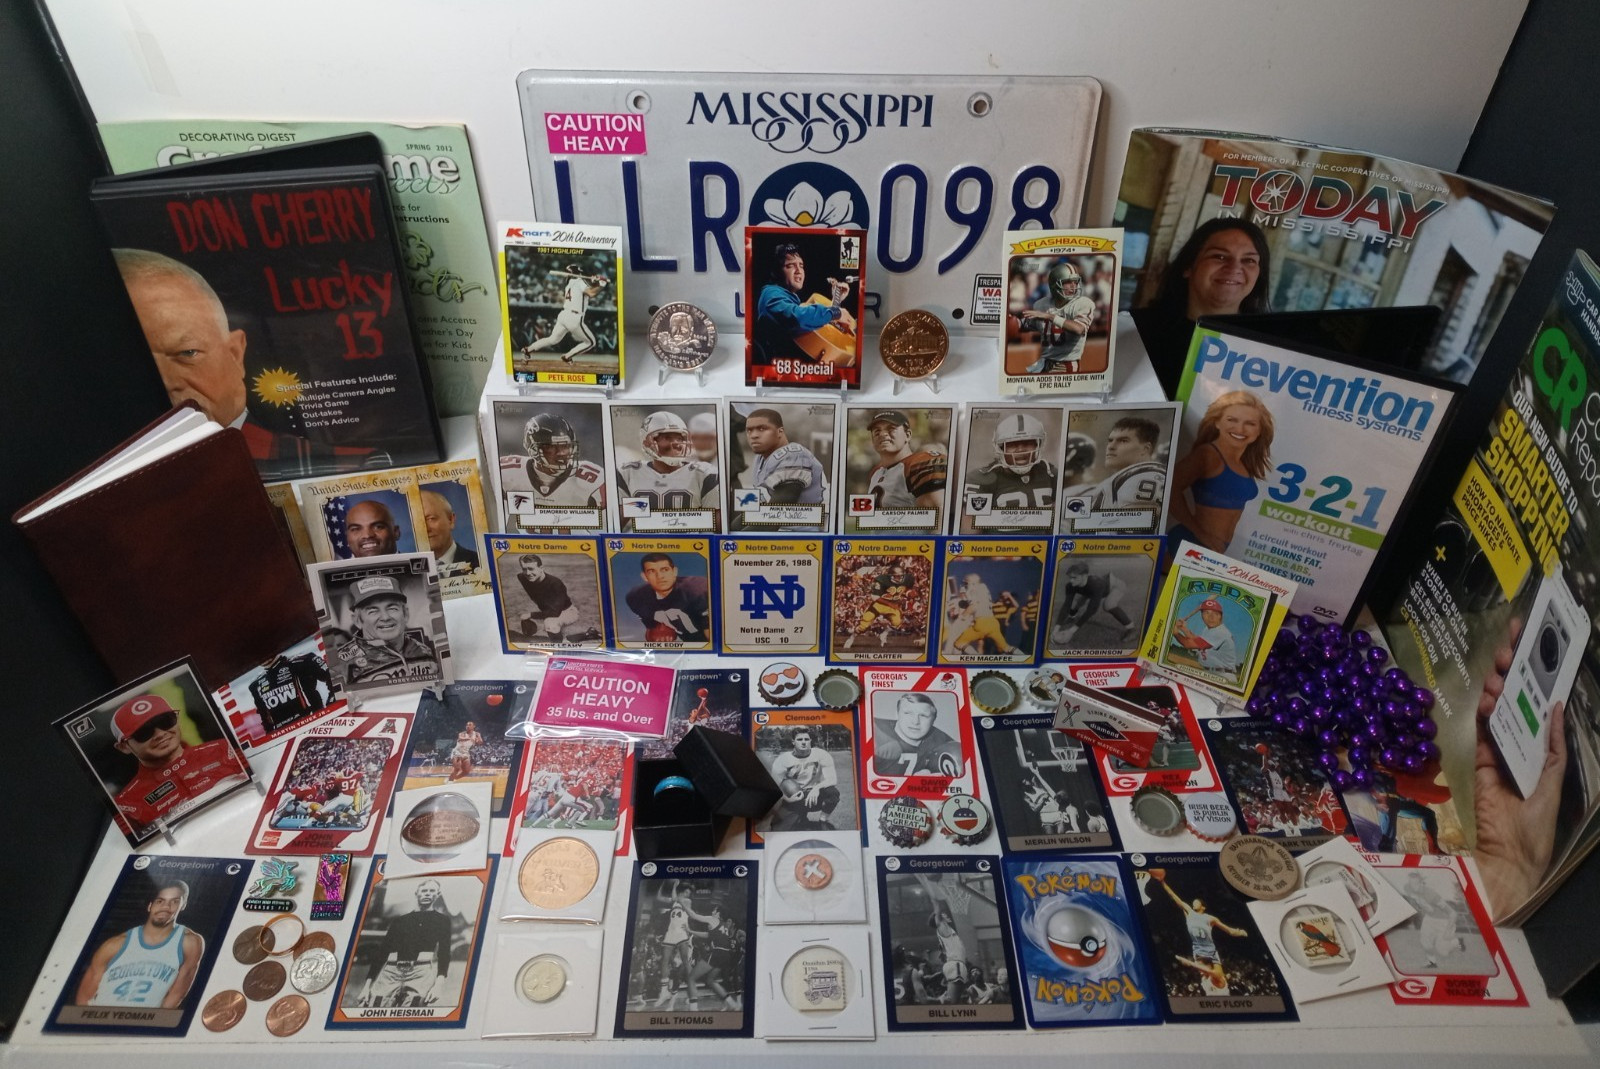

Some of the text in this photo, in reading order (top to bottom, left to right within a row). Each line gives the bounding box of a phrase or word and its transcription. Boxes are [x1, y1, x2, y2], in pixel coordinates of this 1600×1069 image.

[546, 114, 642, 132] CAUTION
[686, 91, 933, 154] MISSISSIPPI
[179, 133, 296, 142] DECORATING DIGEST
[563, 136, 629, 152] HEAVY
[1223, 152, 1239, 160] FOR
[1241, 153, 1278, 164] MEMBERS
[1279, 157, 1290, 165] OF
[1291, 158, 1329, 172] ELECTRIC
[1330, 165, 1391, 181] COOPERATIVES
[1215, 164, 1448, 240] TODAY
[167, 187, 377, 253] DON CHERRY
[552, 231, 574, 242] 20th
[575, 231, 617, 247] Anniversary
[1027, 237, 1100, 249] FLASHBACKS
[264, 259, 393, 319] Lucky
[335, 310, 385, 360] 13
[793, 361, 834, 377] Special
[276, 373, 398, 392] Special Features Include:
[548, 374, 586, 382] PETE ROSE
[1006, 376, 1035, 384] MONTANA
[1193, 335, 1436, 432] Prevention
[1533, 327, 1587, 430] CR
[296, 385, 396, 403] Multiple Camera Angles
[299, 399, 350, 411] Trivia Game
[302, 408, 343, 419] Out-takes
[1302, 398, 1424, 441] fitness systems
[305, 416, 360, 429] Don's Advice
[1512, 390, 1579, 515] OUR NEW GUIDE TO
[433, 466, 472, 480] Congress
[1500, 408, 1570, 546] SMARTER
[307, 476, 412, 497] United States Congress
[1465, 485, 1500, 540] SHORTAGES
[1485, 436, 1560, 579] SHOPPING
[1266, 504, 1353, 540] workout
[1462, 493, 1497, 551] PRICE HIKES
[1470, 476, 1521, 565] HOW TO NAVIGATE
[518, 543, 568, 552] Notre Dame
[745, 543, 795, 552] Notre Dame
[1248, 539, 1267, 551] that
[1270, 546, 1303, 562] BURNS
[1259, 533, 1289, 548] circuit
[1290, 543, 1327, 559] workout
[733, 558, 812, 569] November 26, 1988
[1244, 548, 1288, 568] FLATTENS
[1259, 563, 1315, 587] TONES YOUR
[1188, 580, 1256, 610] REDS
[1425, 560, 1468, 636] WHEN TO BUY IN
[1414, 580, 1427, 599] GET
[1425, 598, 1446, 635] BIGGER
[740, 626, 804, 635] Notre Dame 27
[1410, 587, 1451, 660] BETTER SERVICE
[754, 636, 790, 645] USC 10
[975, 654, 1013, 662] MACAFEE
[1062, 649, 1123, 657] JACK ROBINSON
[1400, 606, 1453, 719] CR RECOMMENDED MARK
[871, 672, 908, 681] GEORGIA'S
[1083, 670, 1120, 679] GEORGIA'S
[563, 674, 651, 695] CAUTION
[871, 680, 895, 688] FINEST
[1085, 679, 1109, 687] FINEST
[572, 692, 635, 709] HEAVY
[546, 706, 654, 725] 35 lbs. and Over
[785, 714, 822, 722] Clemson
[1003, 718, 1052, 727] Georgetown
[270, 723, 296, 740] MARTIN
[1090, 723, 1120, 739] diamond
[888, 812, 925, 822] AMERICA
[897, 805, 919, 815] KEEP
[892, 819, 919, 828] GREAT
[1025, 836, 1092, 846] MERLIN WILSON
[158, 859, 216, 870] Georgetown
[909, 859, 965, 869] Georgetown
[1155, 855, 1210, 864] Georgetown
[666, 864, 722, 874] Georgetown
[1200, 1000, 1253, 1009] ERIC FLOYD
[81, 1010, 155, 1020] FELIX YEOMAN
[360, 1008, 435, 1018] JOHN HEISMAN
[650, 1016, 714, 1025] BILL THOMAS
[928, 1008, 977, 1018] BILL LYNN
